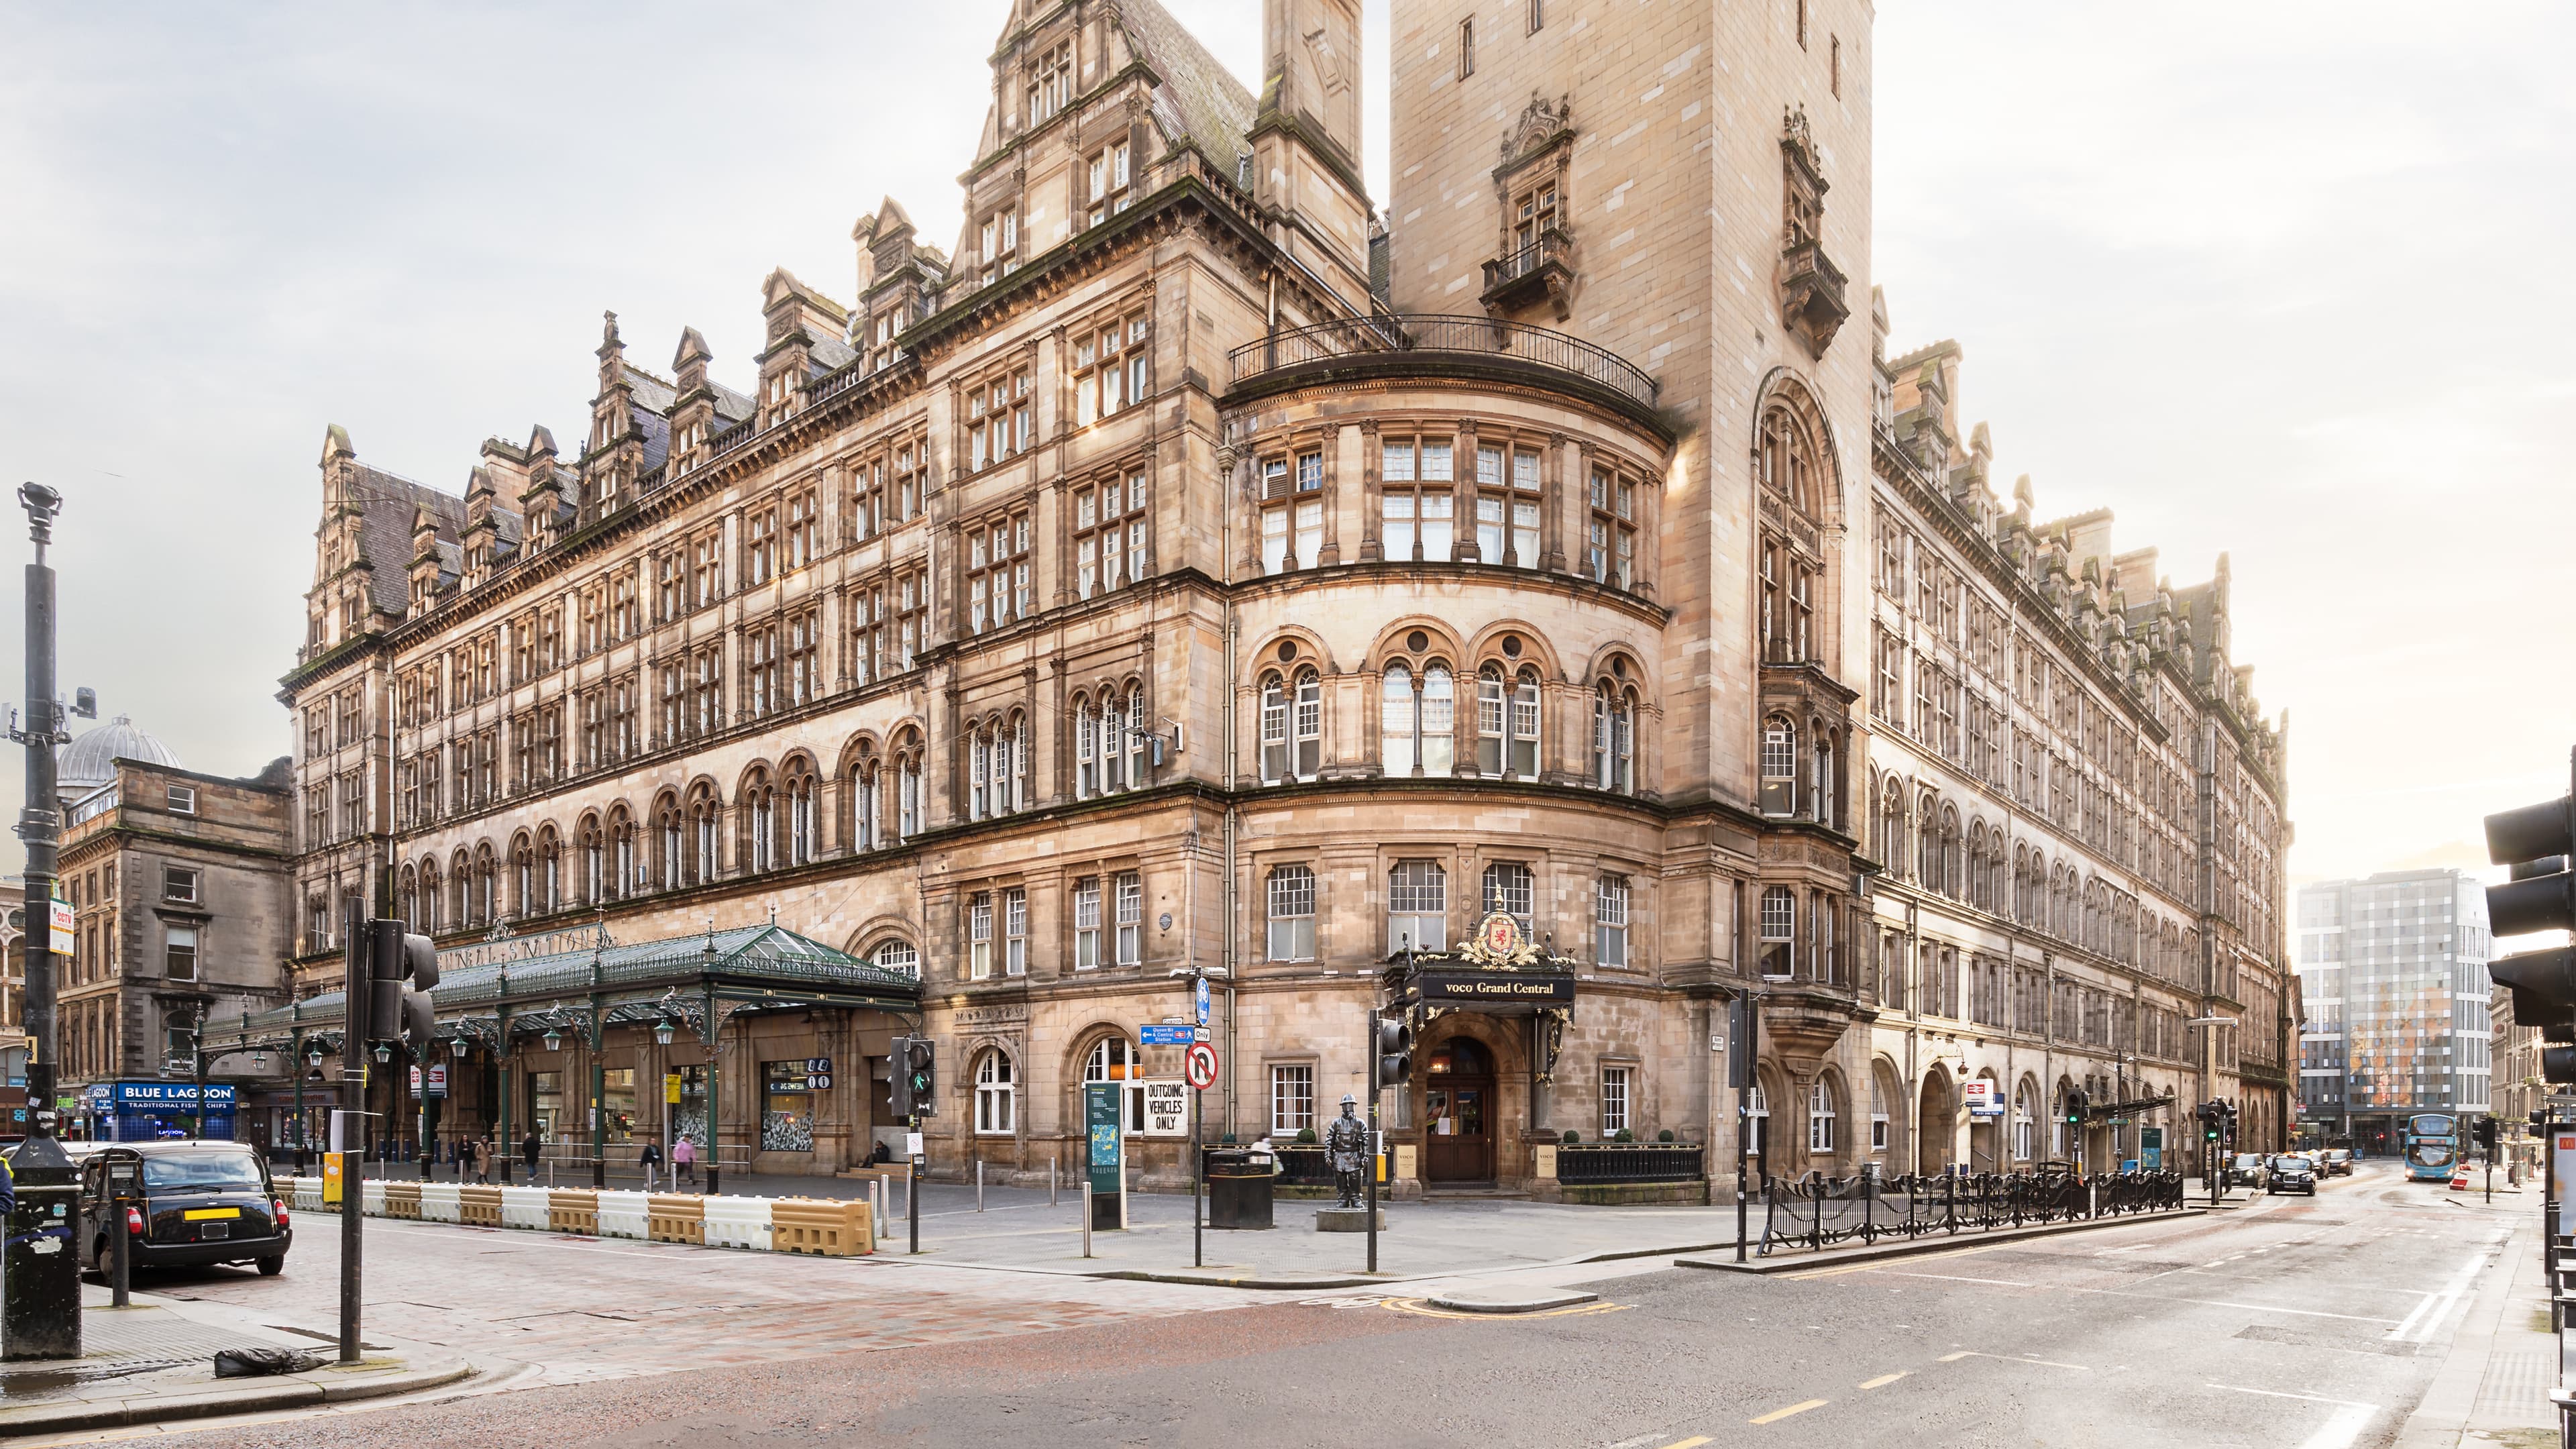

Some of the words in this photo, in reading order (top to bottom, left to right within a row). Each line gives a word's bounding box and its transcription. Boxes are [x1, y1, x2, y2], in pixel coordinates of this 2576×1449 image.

[58, 912, 71, 924] CCTV
[1446, 983, 1472, 993] voco
[1477, 982, 1511, 994] Grand
[1513, 983, 1554, 994] Central
[1199, 1007, 1208, 1020] taxi
[1196, 1031, 1209, 1039] Only
[125, 1087, 161, 1098] BLUE
[1148, 1083, 1183, 1097] OUTGOING
[1148, 1100, 1183, 1114] VEHICLES
[1156, 1116, 1176, 1130] ONLY
